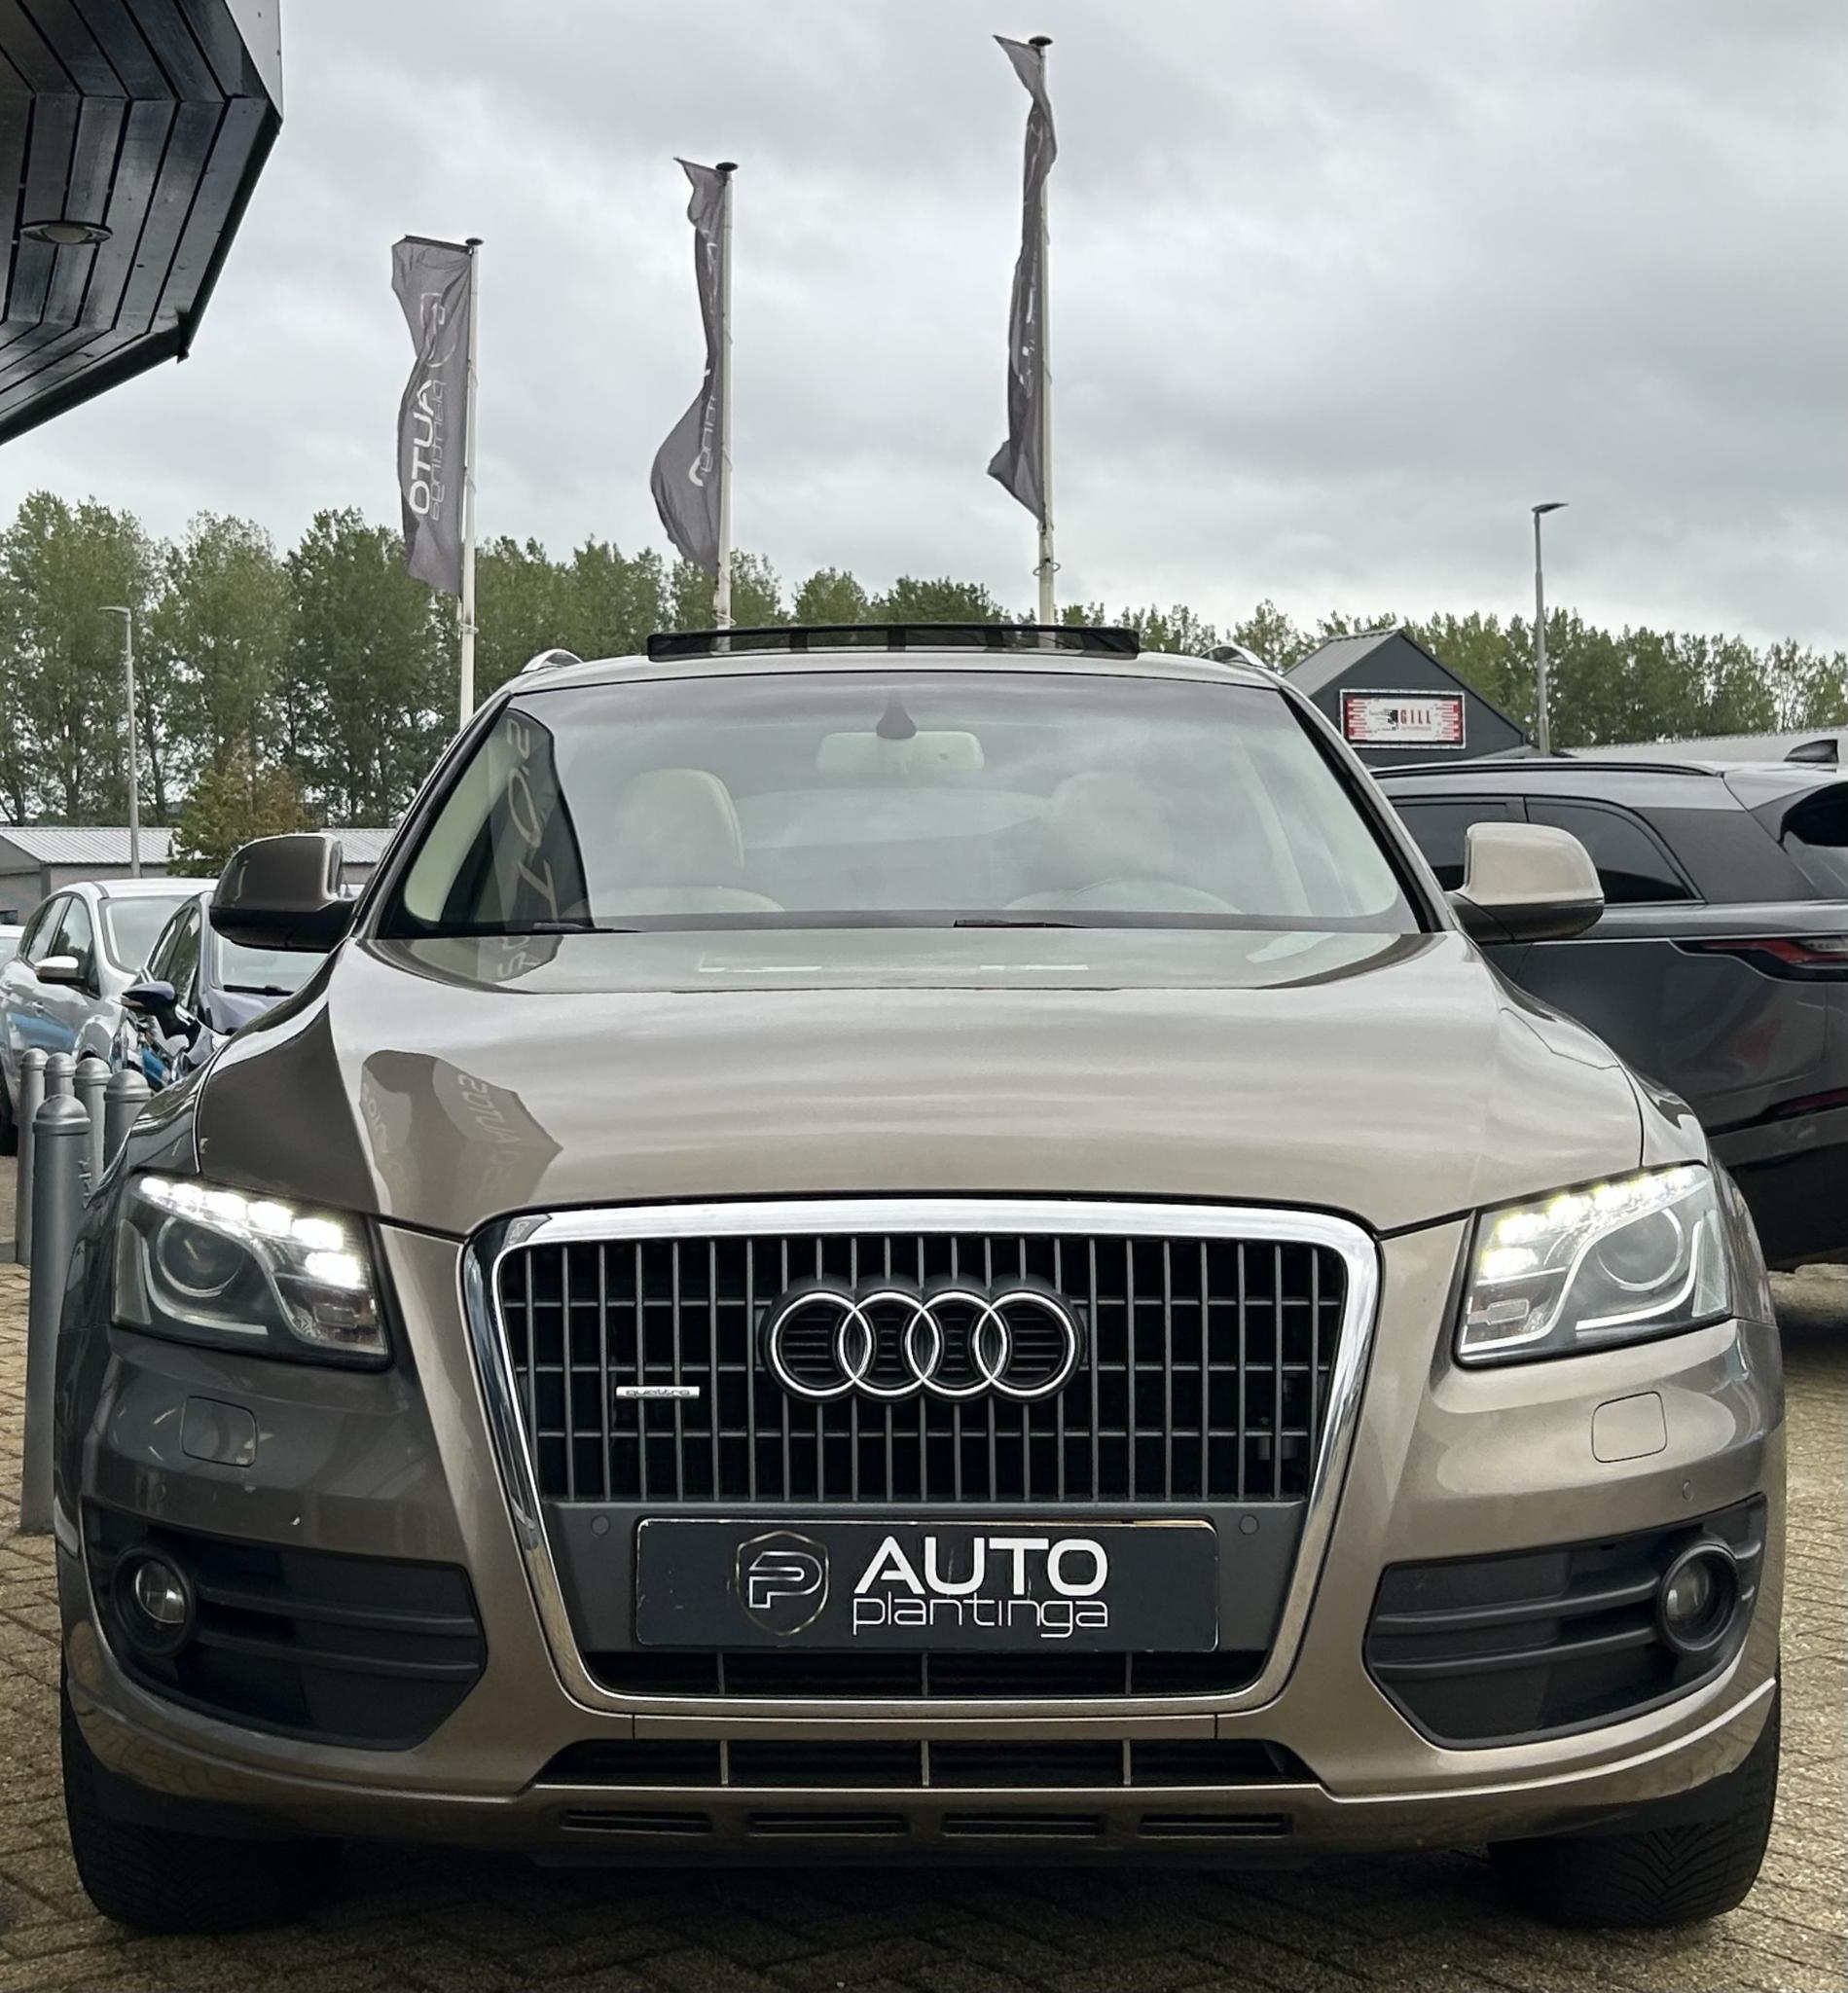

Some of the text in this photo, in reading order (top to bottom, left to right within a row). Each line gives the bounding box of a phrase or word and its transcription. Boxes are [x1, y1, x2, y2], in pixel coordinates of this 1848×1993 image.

[1400, 709, 1431, 724] GILL
[626, 1389, 690, 1397] quattro
[853, 1537, 1109, 1596] AUTO
[852, 1590, 1109, 1638] plantinga
